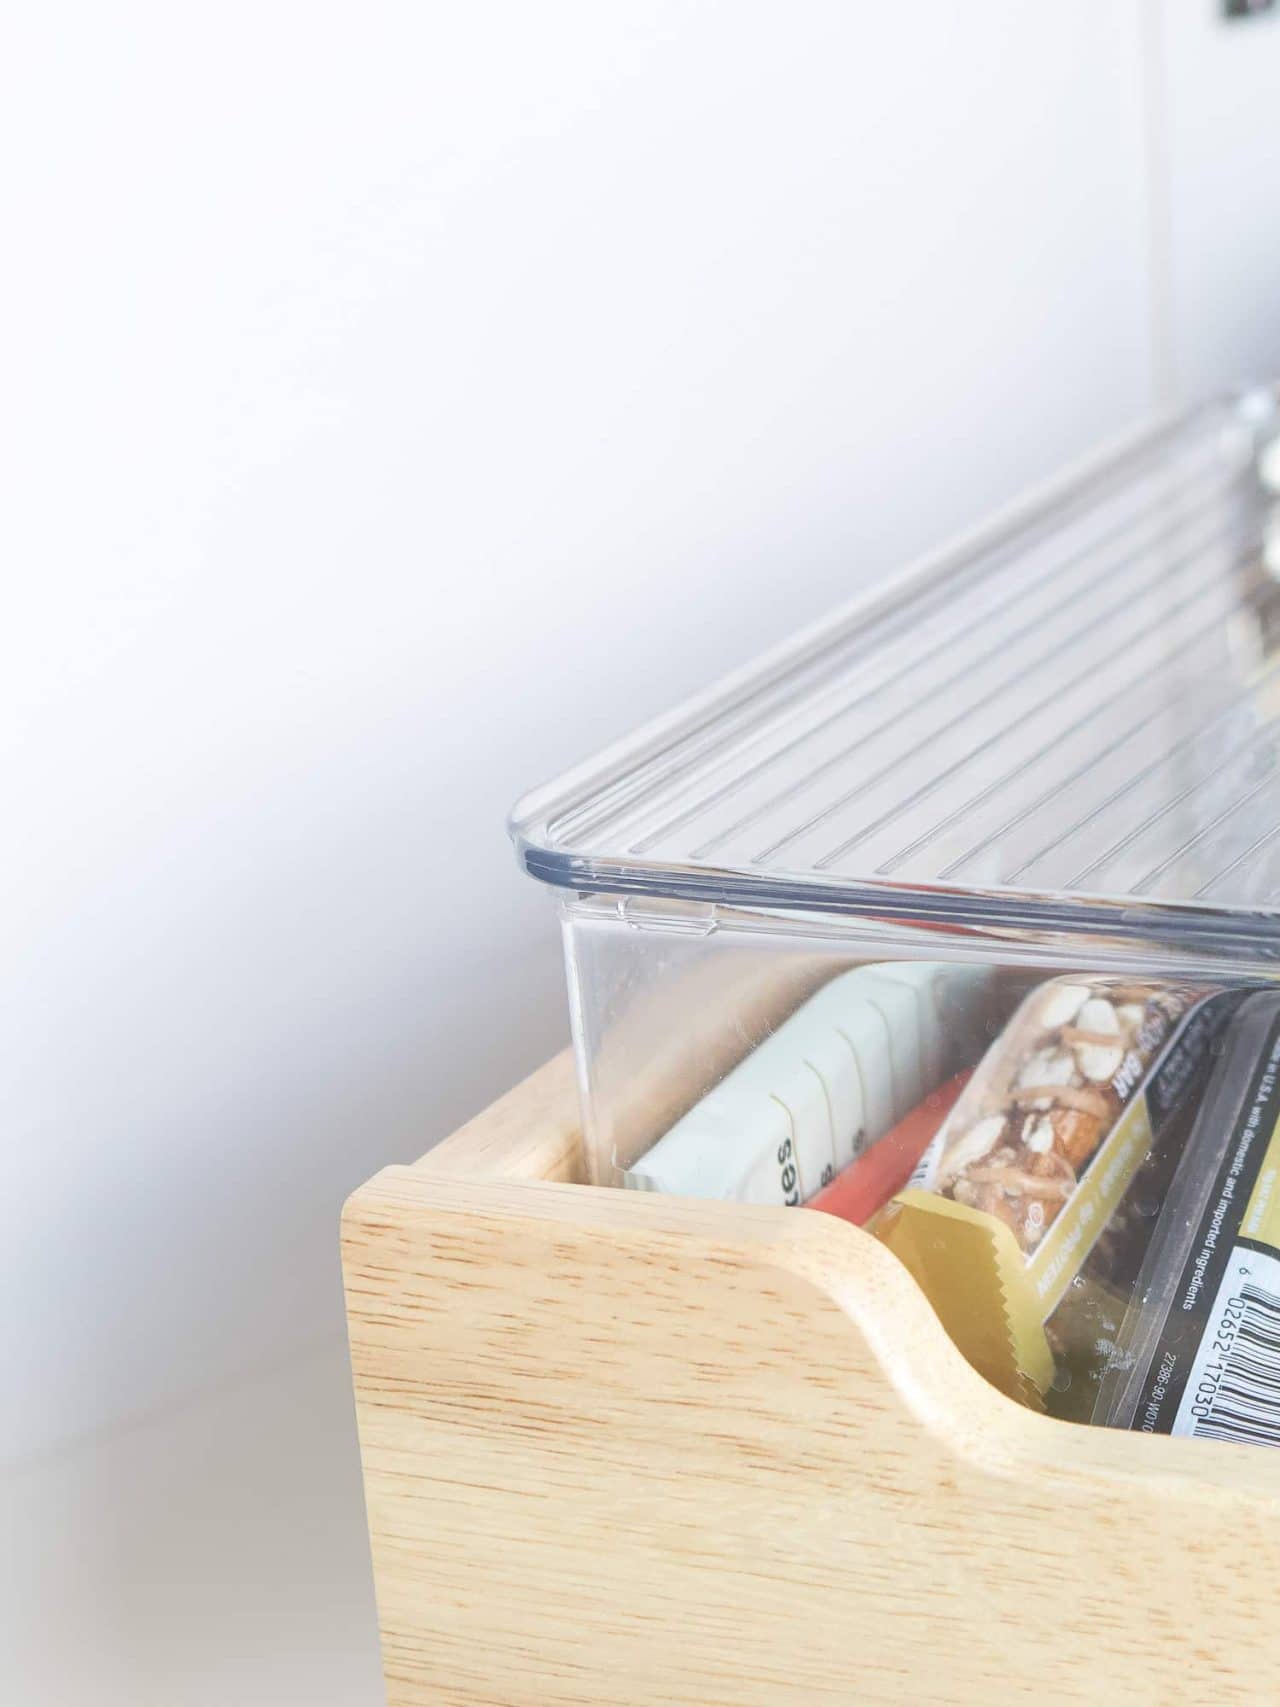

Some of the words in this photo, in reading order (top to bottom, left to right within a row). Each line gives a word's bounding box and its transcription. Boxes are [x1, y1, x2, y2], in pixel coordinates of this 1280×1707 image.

[1247, 1106, 1262, 1129] with
[1230, 1128, 1255, 1177] domestic
[1222, 1176, 1237, 1199] and
[1205, 1198, 1233, 1251] imported
[1183, 1250, 1215, 1311] ingredients
[1238, 1267, 1252, 1277] 6
[1212, 1297, 1247, 1355] 02652
[1190, 1362, 1224, 1418] 17030
